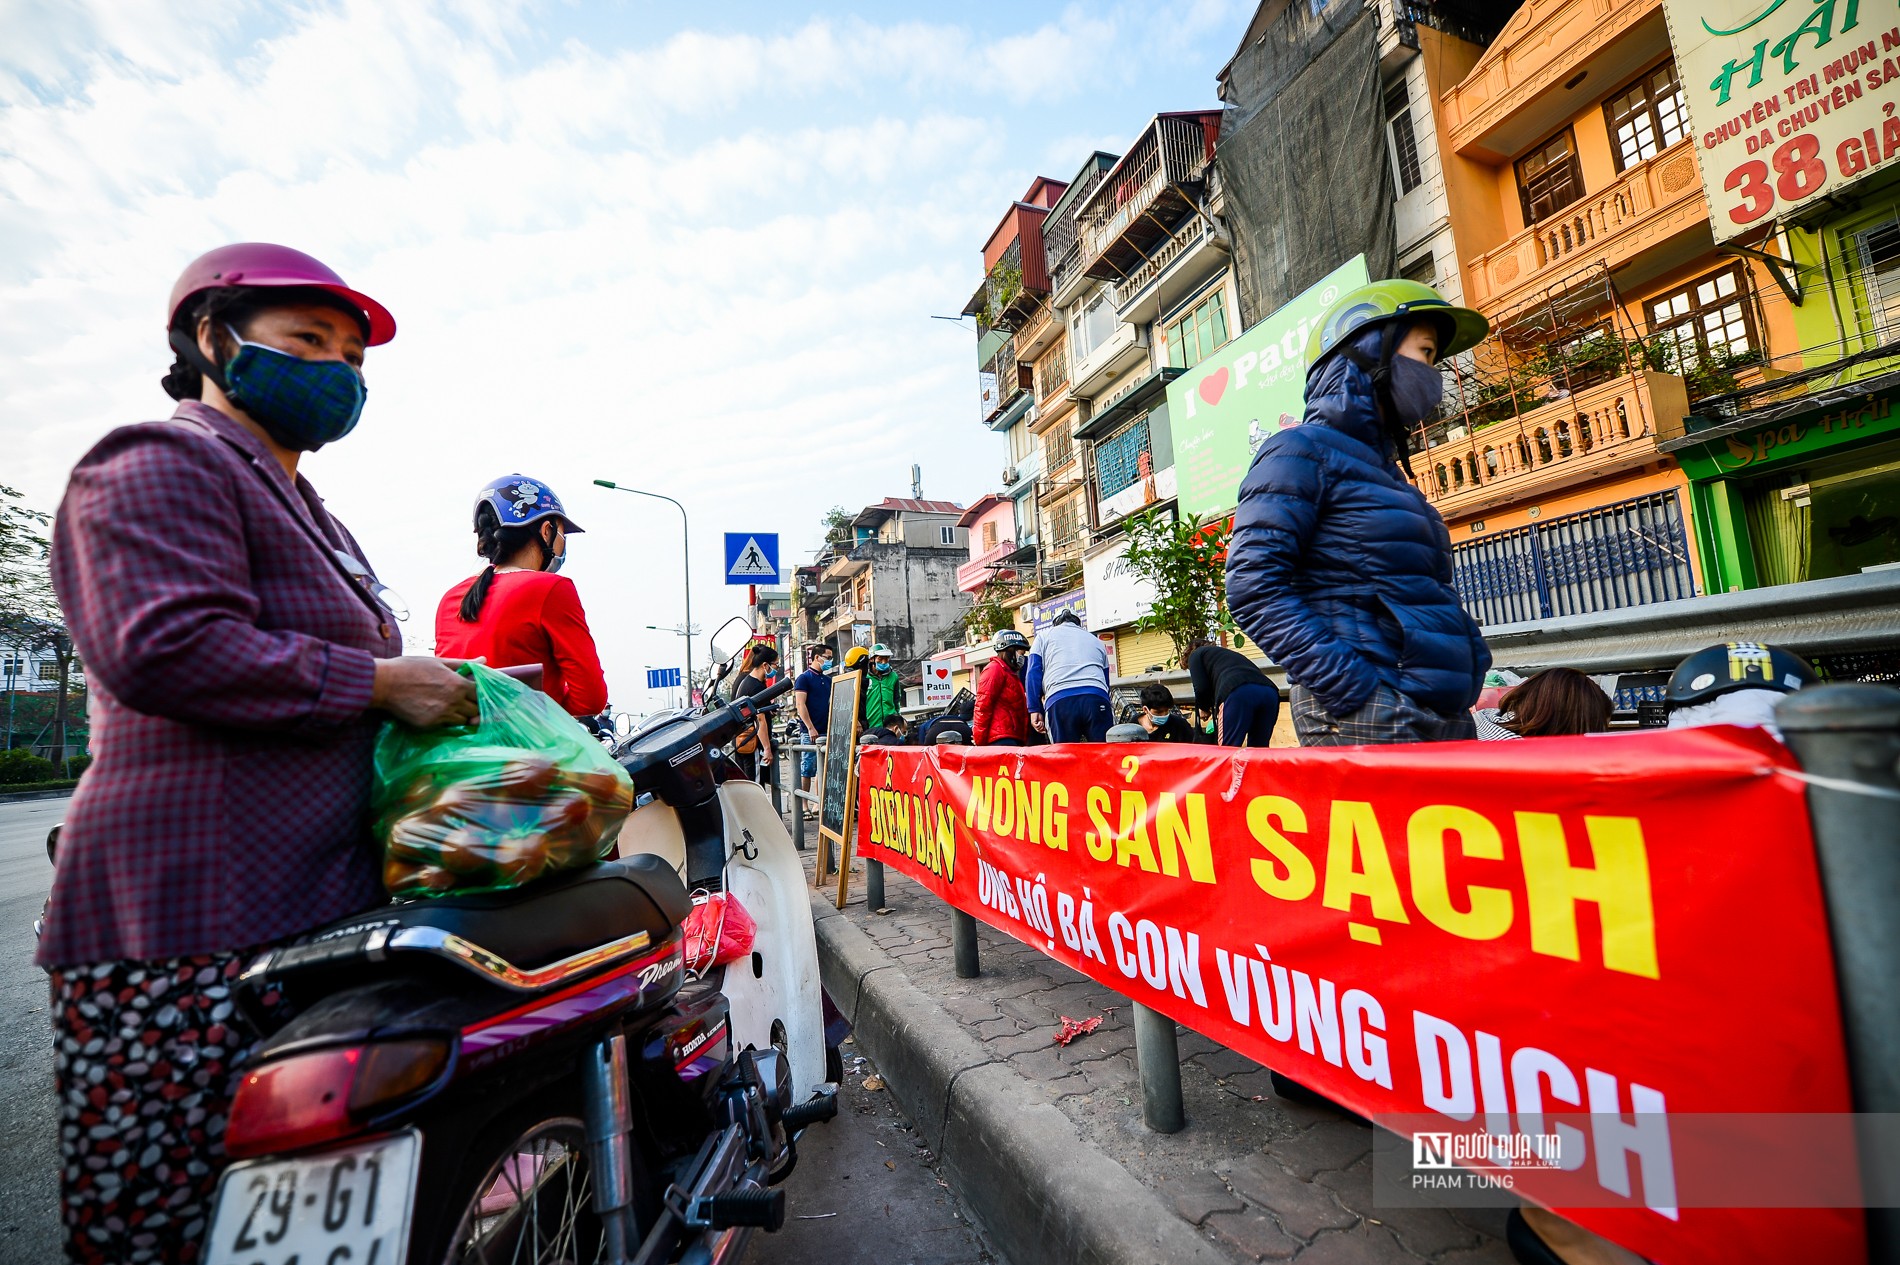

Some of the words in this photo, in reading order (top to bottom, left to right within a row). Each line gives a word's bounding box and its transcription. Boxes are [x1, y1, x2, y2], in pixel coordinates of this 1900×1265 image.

[1703, 94, 1781, 150] CHUYÊN
[1783, 73, 1819, 105] TRỊ
[1822, 40, 1878, 85] MỤN
[1745, 128, 1775, 155] DA
[1777, 79, 1863, 137] CHUYÊN
[1865, 56, 1900, 91] SÂ
[1724, 133, 1827, 224] 38
[1184, 387, 1197, 421] I
[1233, 310, 1328, 391] Pati
[1472, 522, 1483, 532] 40
[926, 665, 932, 675] I
[926, 683, 950, 691] Patin
[869, 754, 913, 860] ĐIỂM
[913, 775, 956, 885] BÁN
[965, 765, 1069, 852] NÔNG
[1085, 755, 1217, 885] SẢN
[1245, 795, 1660, 980] SẠCH
[637, 956, 683, 991] Dream
[1015, 872, 1054, 951] HỘ
[1057, 886, 1107, 967] BÀ
[1108, 911, 1208, 1009] CON
[1215, 943, 1393, 1091] VÙNG
[681, 1032, 707, 1057] HONDA
